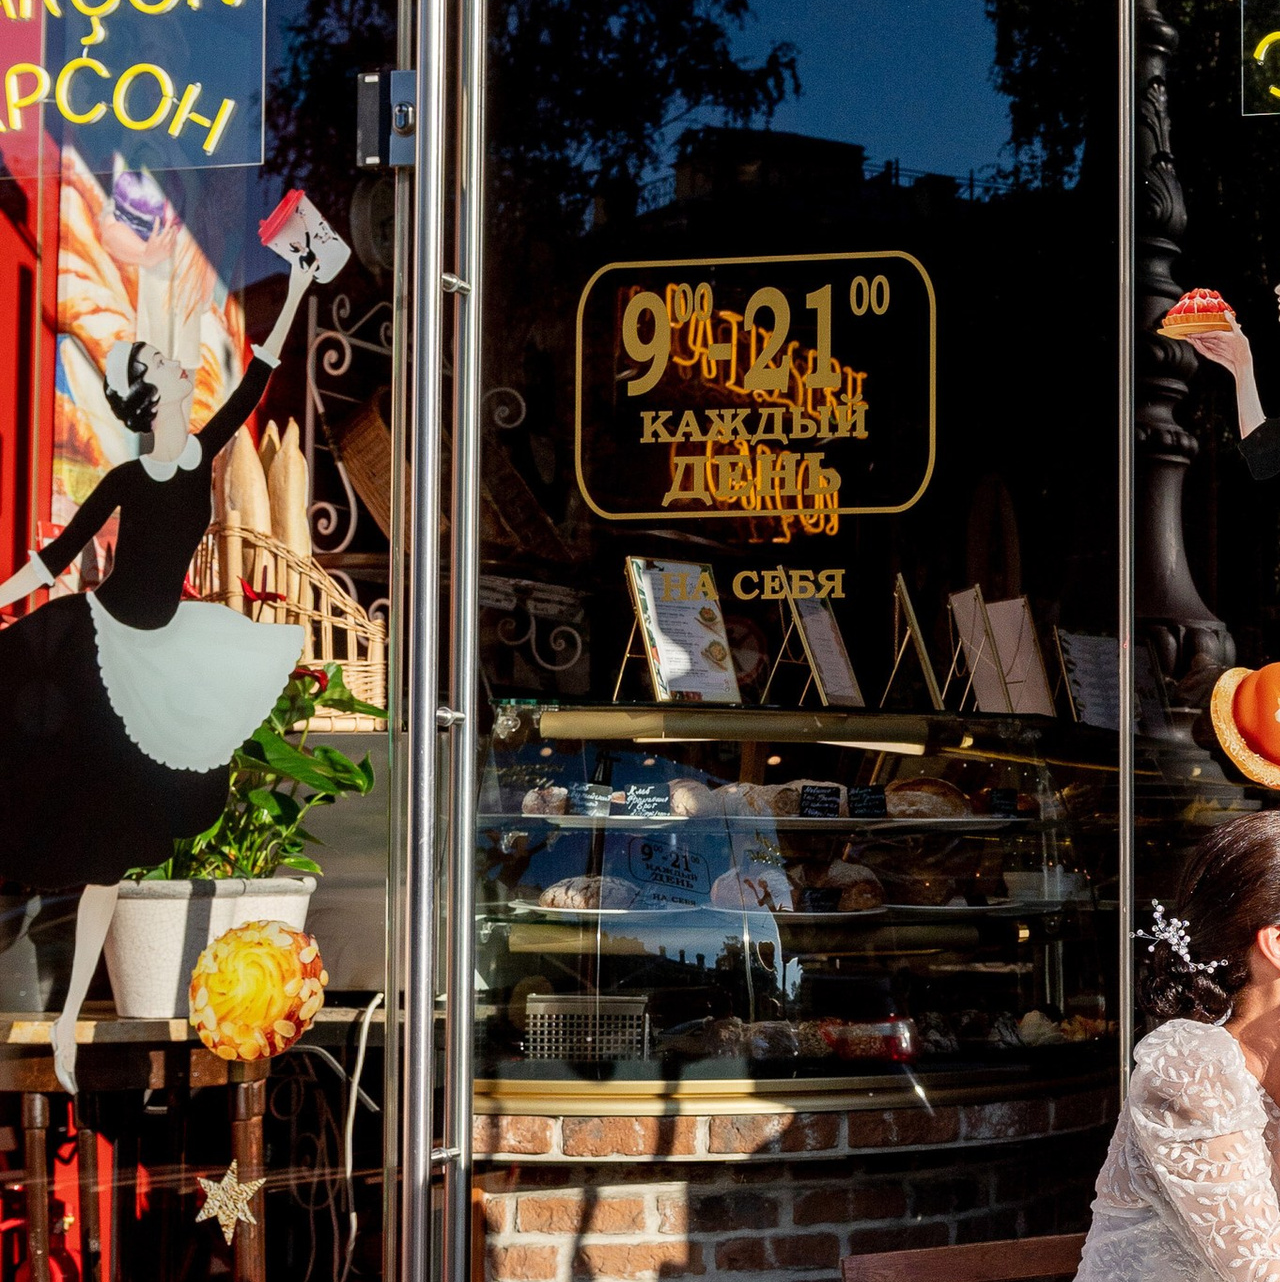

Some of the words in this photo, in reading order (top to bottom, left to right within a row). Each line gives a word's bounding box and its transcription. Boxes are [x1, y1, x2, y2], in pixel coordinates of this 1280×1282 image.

[0, 57, 236, 156] РСОН
[640, 393, 869, 446] КАЖДЫЙ
[661, 452, 842, 508] ДЕНЬ
[661, 573, 719, 601] НА
[732, 569, 846, 601] СЕБЯ
